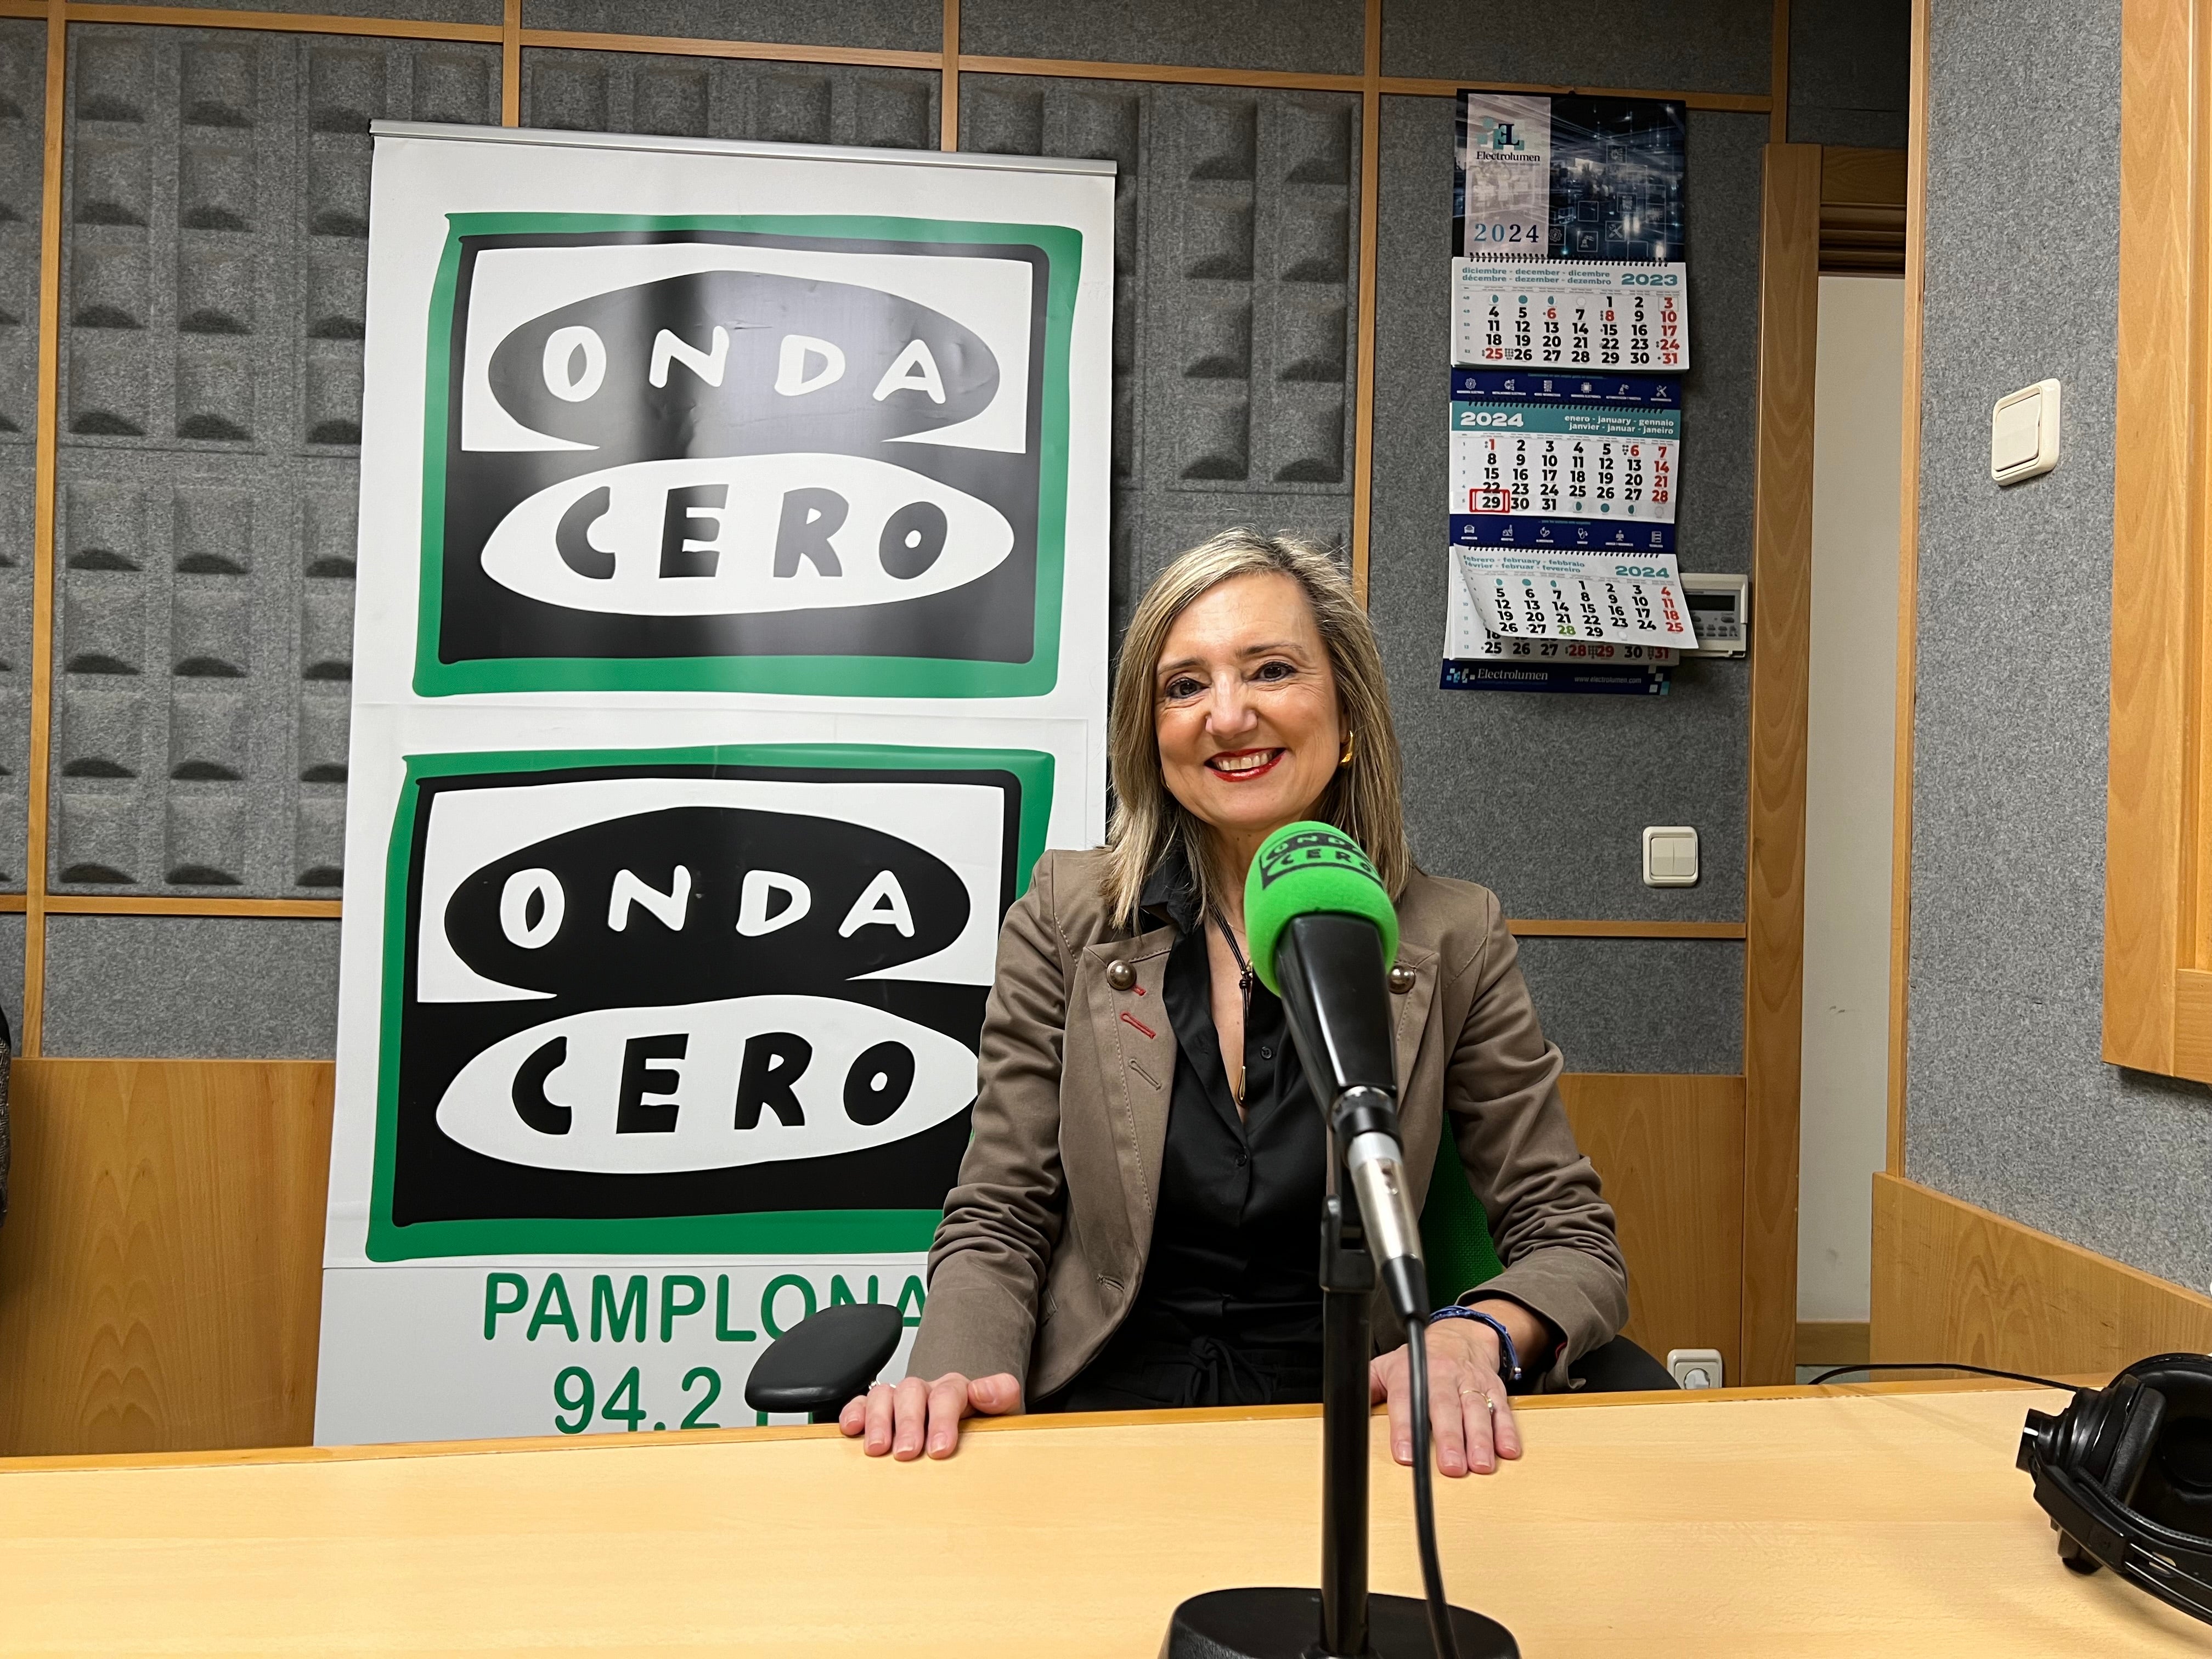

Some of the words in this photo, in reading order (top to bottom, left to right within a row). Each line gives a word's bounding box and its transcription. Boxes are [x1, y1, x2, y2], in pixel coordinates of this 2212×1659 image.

[1476, 151, 1541, 162] Electrolumen
[1474, 224, 1539, 242] 2024
[1622, 273, 1678, 286] 2023
[1606, 296, 1612, 307] 1
[1635, 296, 1643, 308] 2
[1664, 297, 1673, 308] 3
[1489, 307, 1499, 317] 4
[1519, 307, 1527, 318] 5
[1547, 308, 1556, 319] 6
[1576, 309, 1584, 320] 7
[1605, 311, 1615, 321] 8
[1635, 311, 1644, 321] 9
[1661, 311, 1677, 323] 10
[1488, 320, 1500, 331] 11
[1515, 320, 1530, 332] 12
[1544, 322, 1559, 333] 13
[1572, 323, 1589, 334] 14
[1602, 324, 1617, 336] 15
[1632, 324, 1647, 336] 16
[1661, 325, 1677, 336] 17
[1486, 334, 1502, 345] 18
[1515, 335, 1531, 346] 19
[1543, 336, 1561, 347] 20
[1573, 337, 1588, 348] 21
[1601, 338, 1619, 349] 22
[1631, 338, 1649, 349] 23
[1660, 339, 1679, 350] 24
[1486, 348, 1503, 359] 25
[1514, 348, 1532, 360] 26
[1543, 349, 1561, 361] 27
[1571, 351, 1590, 362] 28
[1601, 352, 1619, 364] 29
[1630, 353, 1649, 364] 30
[1663, 353, 1677, 364] 31
[543, 325, 946, 404] ONDA
[1460, 411, 1523, 427] 2024
[1598, 416, 1631, 425] january
[1607, 424, 1635, 432] januar
[1643, 426, 1673, 434] janeiro
[1489, 439, 1494, 450] 1
[1517, 439, 1526, 451] 2
[1545, 441, 1554, 452] 3
[1573, 442, 1583, 453] 4
[1602, 443, 1611, 455] 5
[1630, 445, 1639, 456] 6
[1658, 447, 1667, 458] 7
[1488, 453, 1497, 465] 8
[1516, 454, 1525, 465] 9
[1542, 455, 1558, 466] 10
[1572, 456, 1583, 467] 11
[1599, 458, 1613, 470] 12
[1627, 459, 1641, 471] 13
[1654, 461, 1669, 472] 14
[1485, 468, 1499, 479] 15
[1513, 469, 1528, 480] 16
[1542, 470, 1557, 481] 17
[1570, 471, 1585, 482] 18
[1599, 472, 1613, 484] 19
[1625, 473, 1643, 486] 20
[1655, 476, 1667, 487] 21
[1483, 482, 1500, 494] 22
[1512, 483, 1529, 494] 23
[1540, 484, 1559, 495] 24
[1570, 485, 1586, 497] 25
[1597, 487, 1615, 499] 26
[1625, 488, 1642, 500] 27
[1652, 490, 1668, 502] 28
[1482, 496, 1500, 508] 29
[1511, 498, 1529, 509] 30
[1542, 499, 1556, 510] 31
[555, 483, 949, 580] CERO
[1615, 566, 1669, 578] 2024
[1578, 580, 1585, 590] 1
[1605, 583, 1615, 592] 2
[1633, 585, 1642, 594] 3
[1661, 586, 1671, 596] 4
[1496, 589, 1505, 597] 5
[1526, 589, 1535, 598] 6
[1553, 590, 1561, 599] 7
[1581, 592, 1590, 601] 8
[1609, 595, 1617, 604] 9
[1632, 597, 1649, 606] 10
[1662, 599, 1674, 608] 11
[1495, 600, 1511, 609] 12
[1524, 601, 1540, 610] 13
[1552, 601, 1569, 612] 14
[1580, 603, 1596, 613] 15
[1608, 606, 1624, 616] 16
[1635, 608, 1650, 618] 17
[1663, 610, 1679, 620] 18
[1497, 611, 1513, 620] 19
[1526, 612, 1544, 622] 20
[1556, 613, 1571, 624] 21
[1582, 615, 1601, 625] 22
[1611, 617, 1628, 628] 23
[1637, 620, 1656, 630] 24
[1666, 622, 1684, 632] 25
[1499, 622, 1518, 633] 26
[1528, 624, 1546, 634] 27
[1557, 625, 1576, 635] 28
[1585, 627, 1604, 637] 29
[1485, 642, 1502, 653] 25
[1513, 642, 1530, 654] 26
[1541, 644, 1558, 656] 27
[1568, 645, 1587, 656] 28
[1597, 645, 1615, 657] 29
[1624, 646, 1643, 658] 30
[1655, 647, 1669, 658] 31
[1477, 669, 1548, 680] Electrolumen
[1274, 836, 1358, 853] OND
[1281, 849, 1372, 872] CERO
[500, 864, 915, 949] ONDA
[511, 1031, 916, 1136] CERO
[554, 1365, 721, 1434] 94.2
